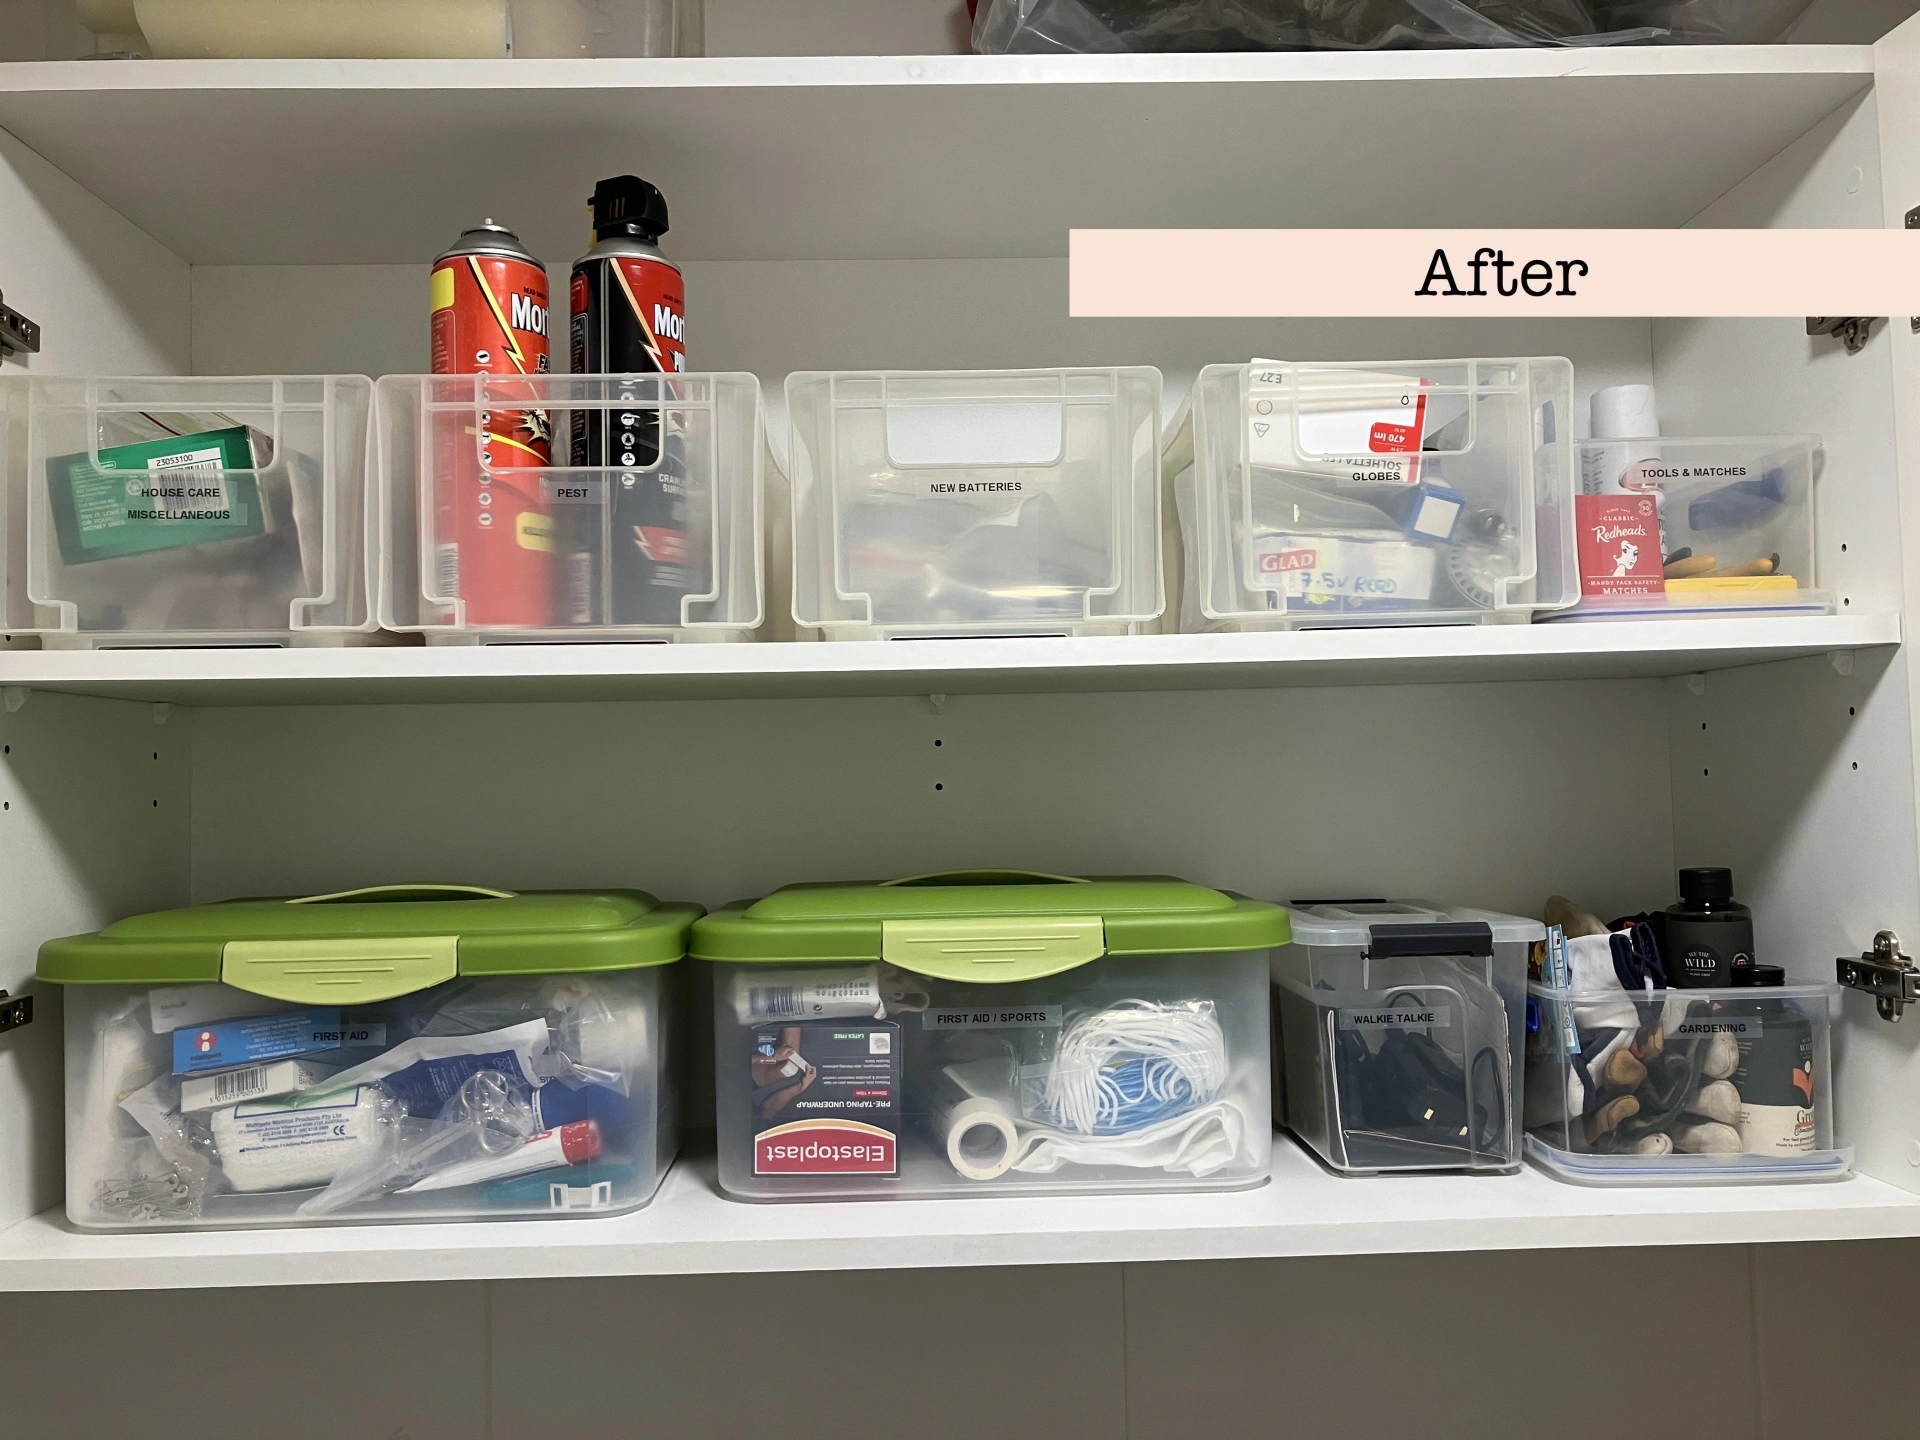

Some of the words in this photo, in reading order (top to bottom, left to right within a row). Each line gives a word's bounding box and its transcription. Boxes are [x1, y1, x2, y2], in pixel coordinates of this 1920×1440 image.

[1259, 371, 1283, 384] E27
[1373, 431, 1386, 441] lm
[1387, 433, 1406, 443] 470
[156, 454, 194, 467] 23053100
[1346, 458, 1402, 471] SOLHETTA
[1352, 471, 1401, 481] GLOBES
[1641, 468, 1679, 478] TOOLS
[1682, 468, 1690, 477] &
[1693, 466, 1747, 477] MATCHES
[930, 483, 956, 493] NEW
[958, 481, 1022, 492] BATTERIES
[141, 488, 184, 498] HOUSE
[187, 488, 220, 497] CARE
[557, 488, 588, 498] PEST
[127, 510, 230, 520] MISCELLANEOUS
[1591, 523, 1646, 543] Redheads
[1261, 553, 1314, 571] GLAD
[1602, 587, 1648, 595] MATCHES
[1685, 958, 1716, 968] WILD
[937, 1013, 968, 1024] FIRST
[972, 1013, 990, 1023] AID
[993, 1013, 997, 1023] /
[1000, 1011, 1046, 1023] SPORTS
[1354, 1014, 1393, 1024] WALKIE
[1396, 1013, 1435, 1023] TALKIE
[1678, 1023, 1746, 1034] GARDENING
[313, 1031, 347, 1041] FIRST
[349, 1031, 369, 1040] AID
[796, 1100, 845, 1108] UNDERWRAP
[846, 1100, 891, 1108] PRE-TAPING
[766, 1141, 885, 1162] Elastoplast
